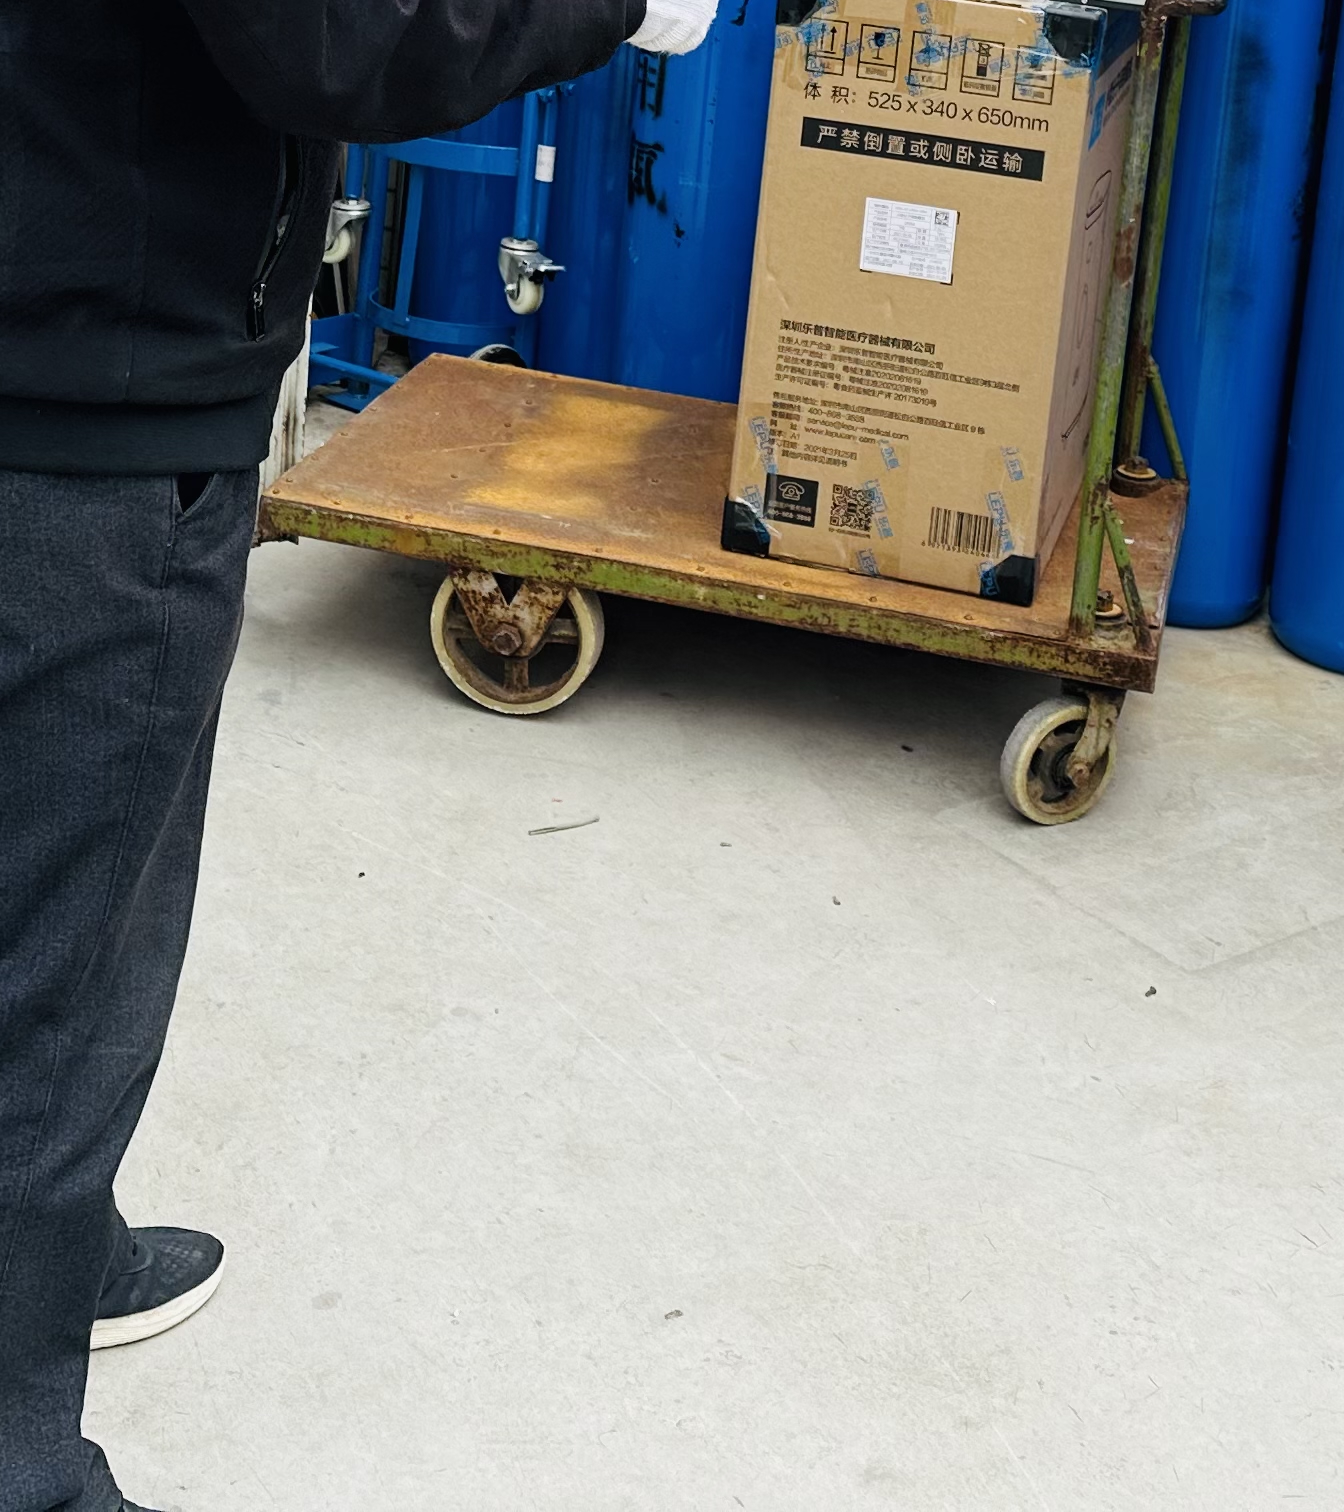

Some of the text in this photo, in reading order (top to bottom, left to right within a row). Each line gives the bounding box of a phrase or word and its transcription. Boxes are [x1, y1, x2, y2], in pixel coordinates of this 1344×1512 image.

[868, 91, 903, 112] 525
[922, 98, 958, 119] 340
[977, 107, 1049, 133] 650mm
[817, 124, 1024, 174] 严禁倒置或侧卧运输
